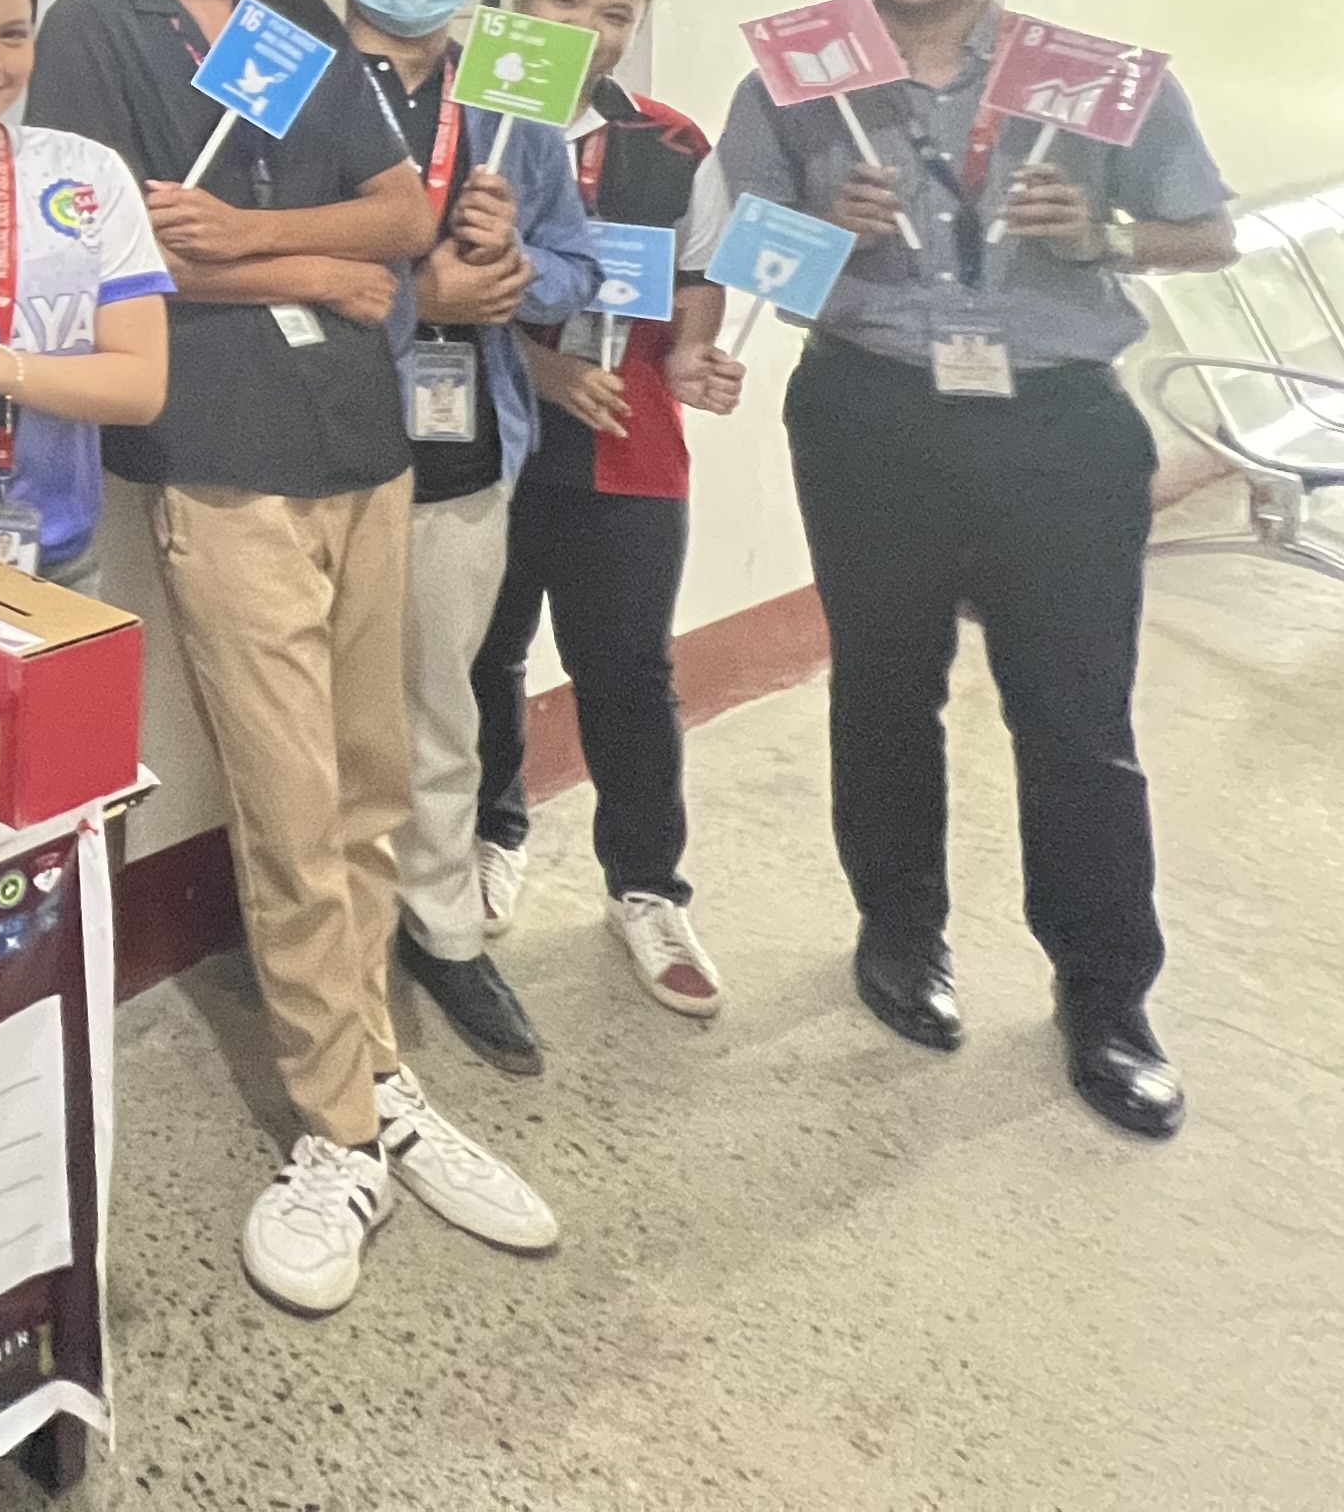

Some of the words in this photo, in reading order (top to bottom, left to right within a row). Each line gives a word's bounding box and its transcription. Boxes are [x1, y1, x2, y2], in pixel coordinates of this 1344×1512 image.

[239, 4, 265, 32] 16
[482, 13, 507, 36] 15
[754, 23, 770, 41] 4
[1023, 25, 1046, 47] 8
